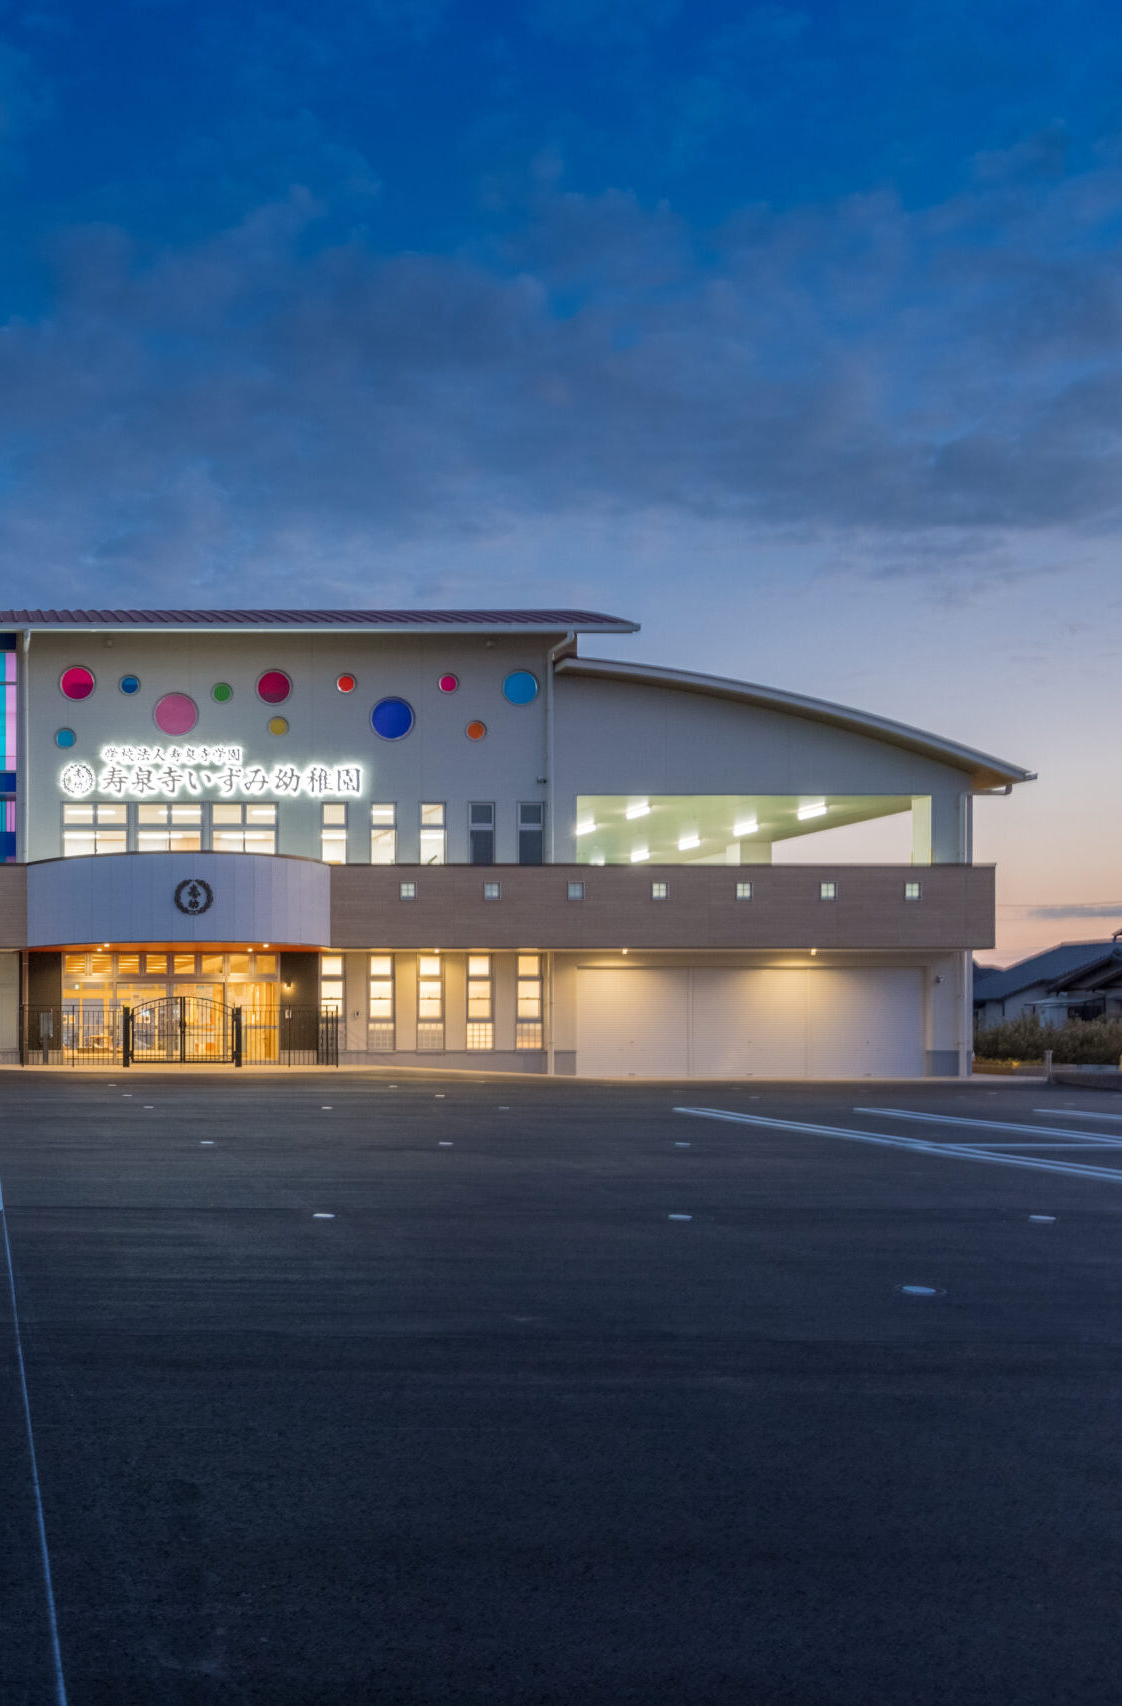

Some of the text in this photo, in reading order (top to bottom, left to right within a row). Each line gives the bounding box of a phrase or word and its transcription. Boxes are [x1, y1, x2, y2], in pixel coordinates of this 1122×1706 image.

[101, 766, 361, 794] 寿泉寺いずみ幼稚園
